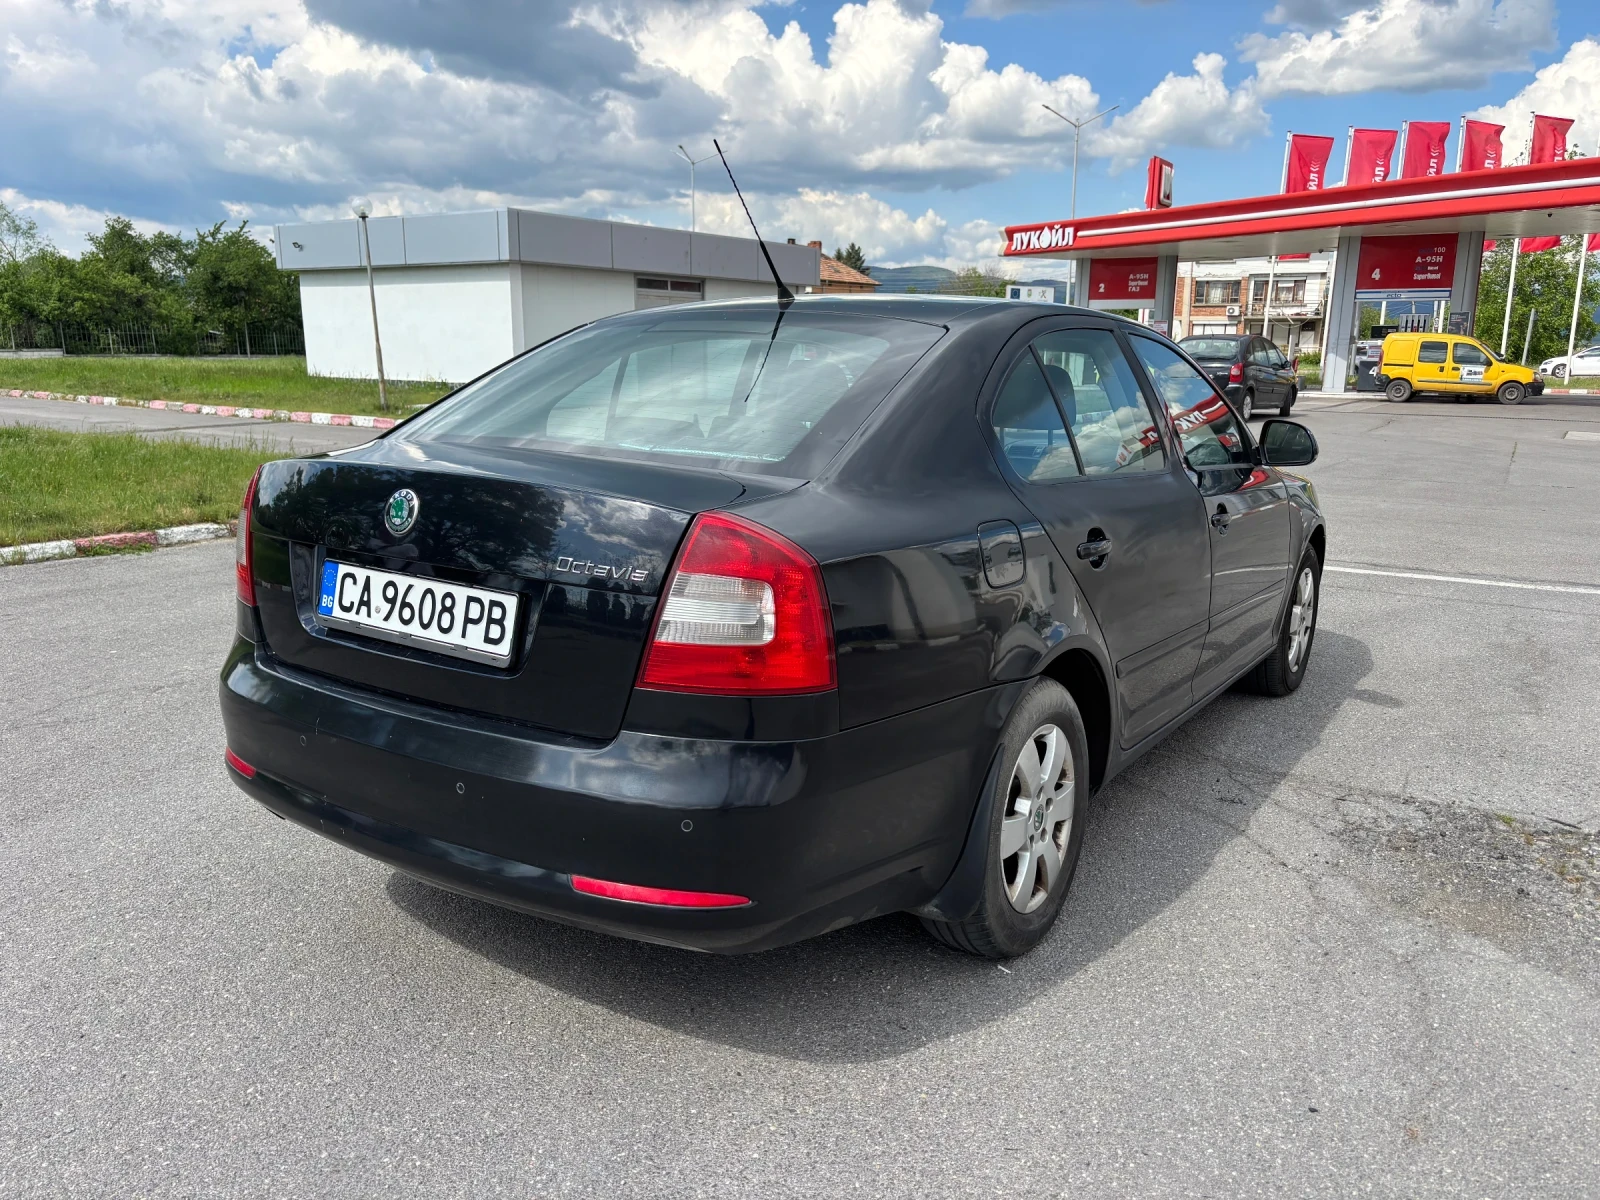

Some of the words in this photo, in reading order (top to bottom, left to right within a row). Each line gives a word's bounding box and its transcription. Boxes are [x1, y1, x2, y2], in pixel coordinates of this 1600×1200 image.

[1011, 224, 1075, 251] ЛУКОЙЛ
[1371, 268, 1381, 280] 4
[1098, 283, 1105, 293] 2
[555, 556, 650, 582] Octavia
[321, 594, 333, 608] BG
[382, 580, 456, 635] 9608
